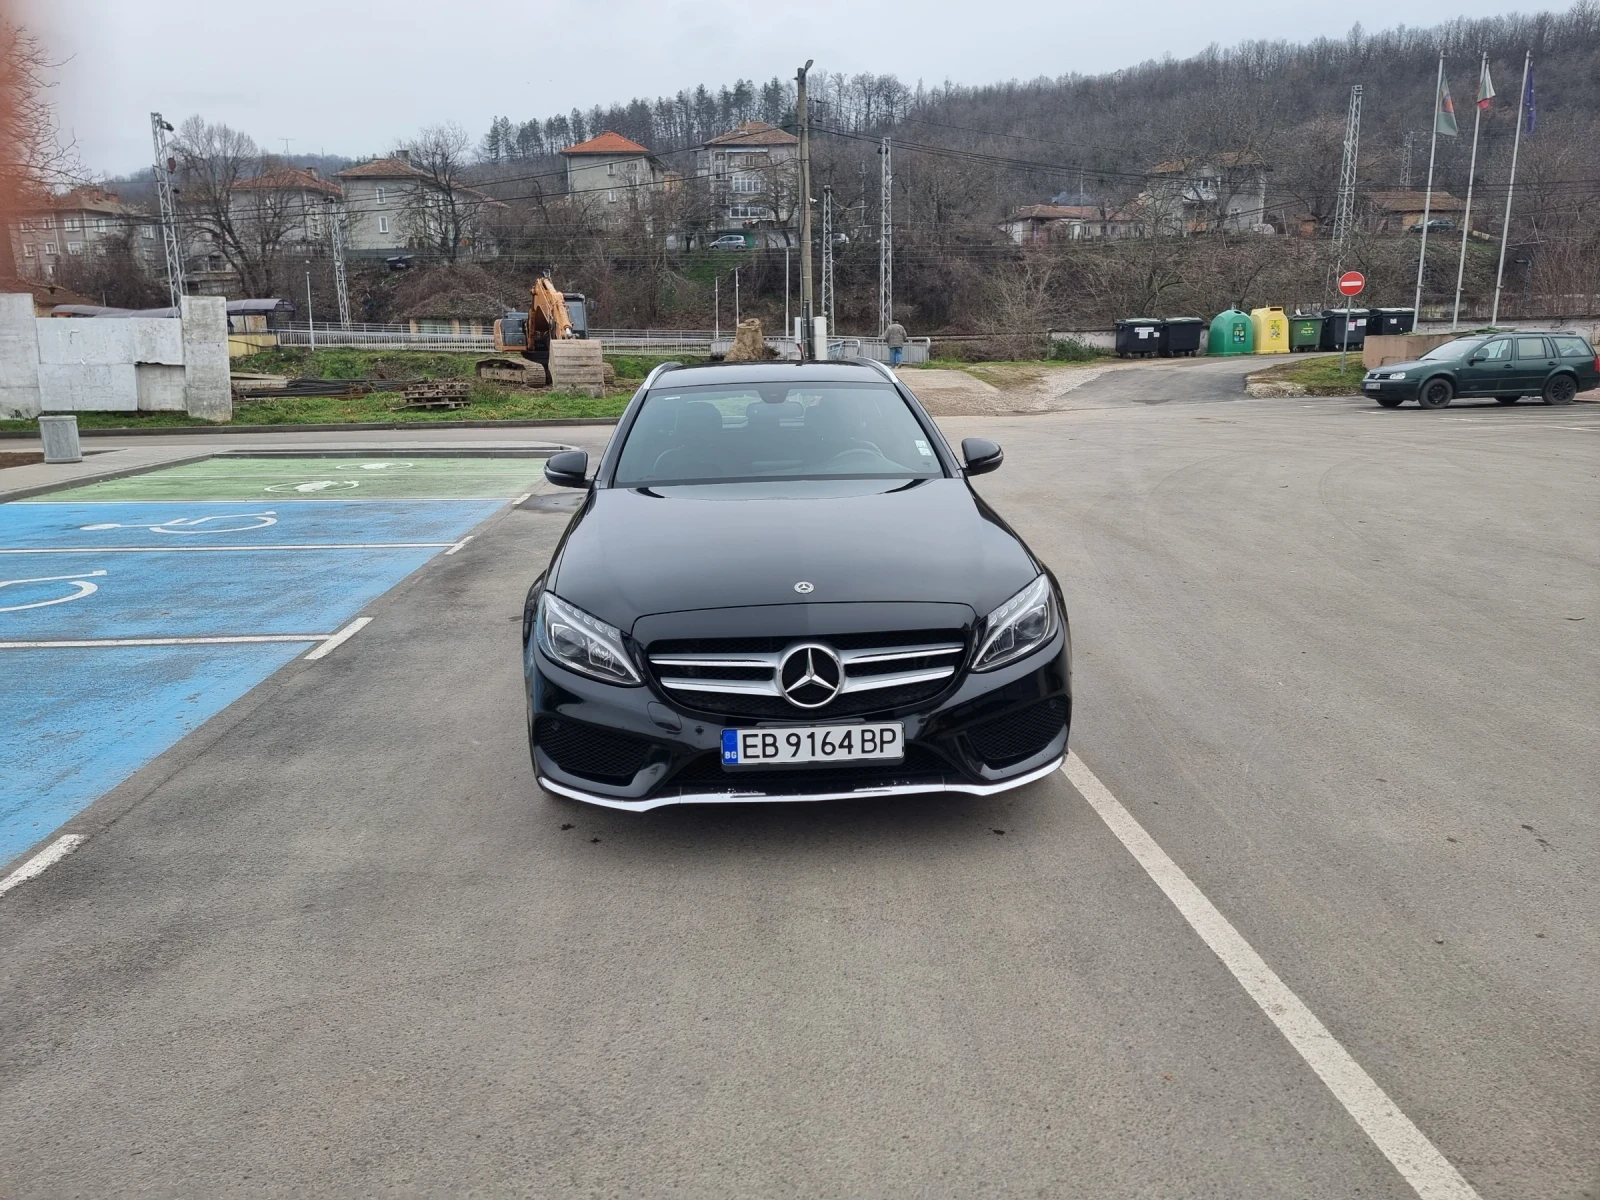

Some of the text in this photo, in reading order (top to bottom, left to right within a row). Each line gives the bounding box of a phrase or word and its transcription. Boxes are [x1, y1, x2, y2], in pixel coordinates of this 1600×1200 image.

[742, 728, 897, 759] EB 9164 BP
[724, 751, 737, 759] BG
